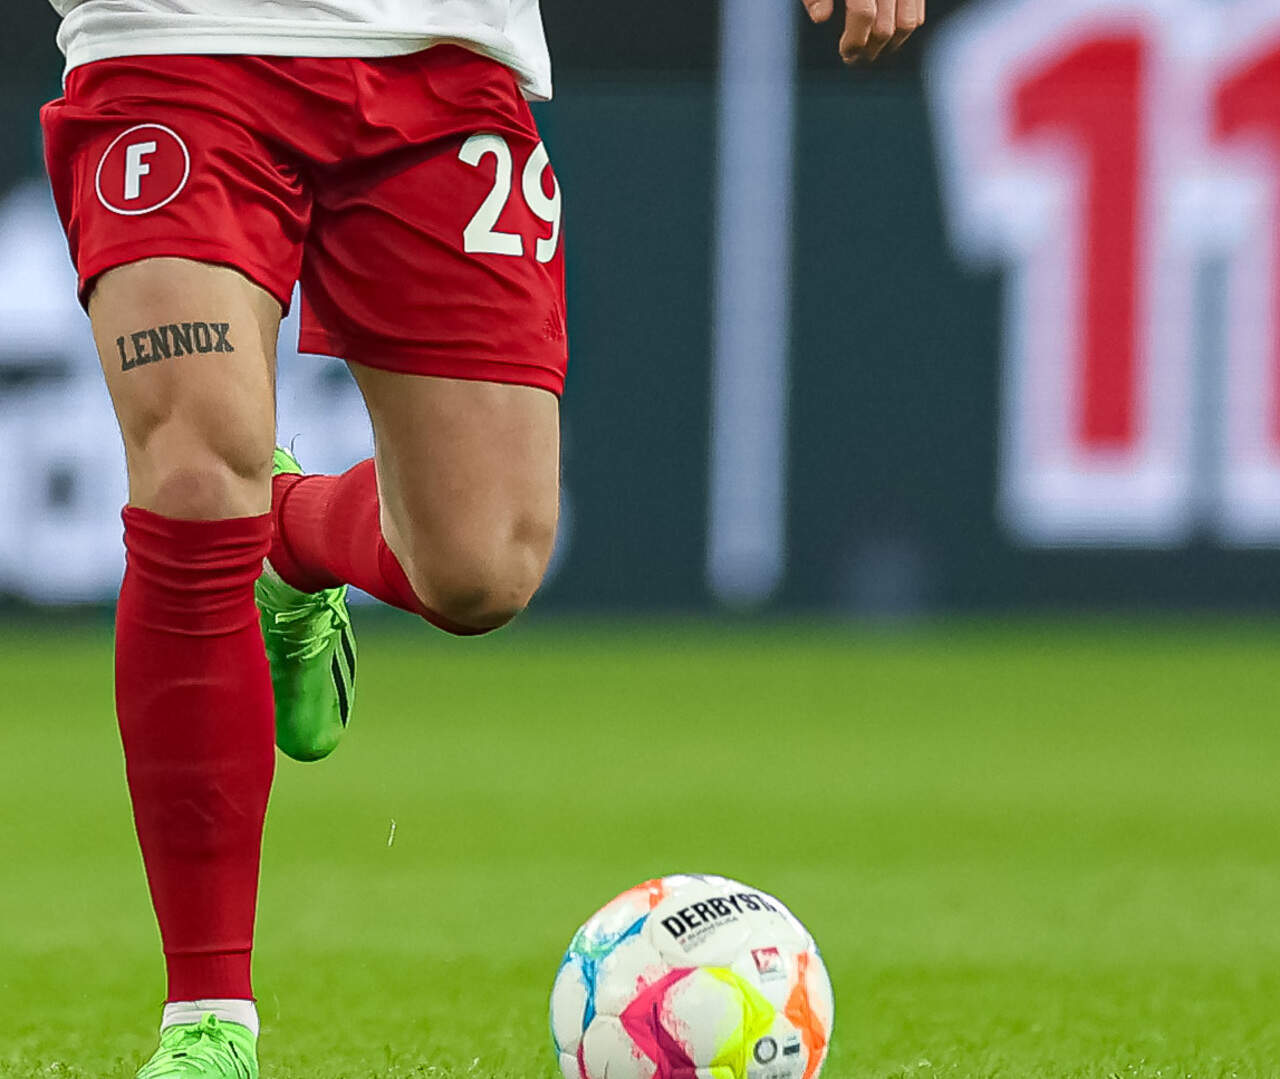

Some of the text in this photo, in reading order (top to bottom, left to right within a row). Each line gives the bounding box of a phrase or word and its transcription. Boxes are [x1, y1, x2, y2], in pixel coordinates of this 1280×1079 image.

[124, 141, 157, 200] F
[457, 133, 562, 264] 29
[116, 322, 235, 372] LENNOX
